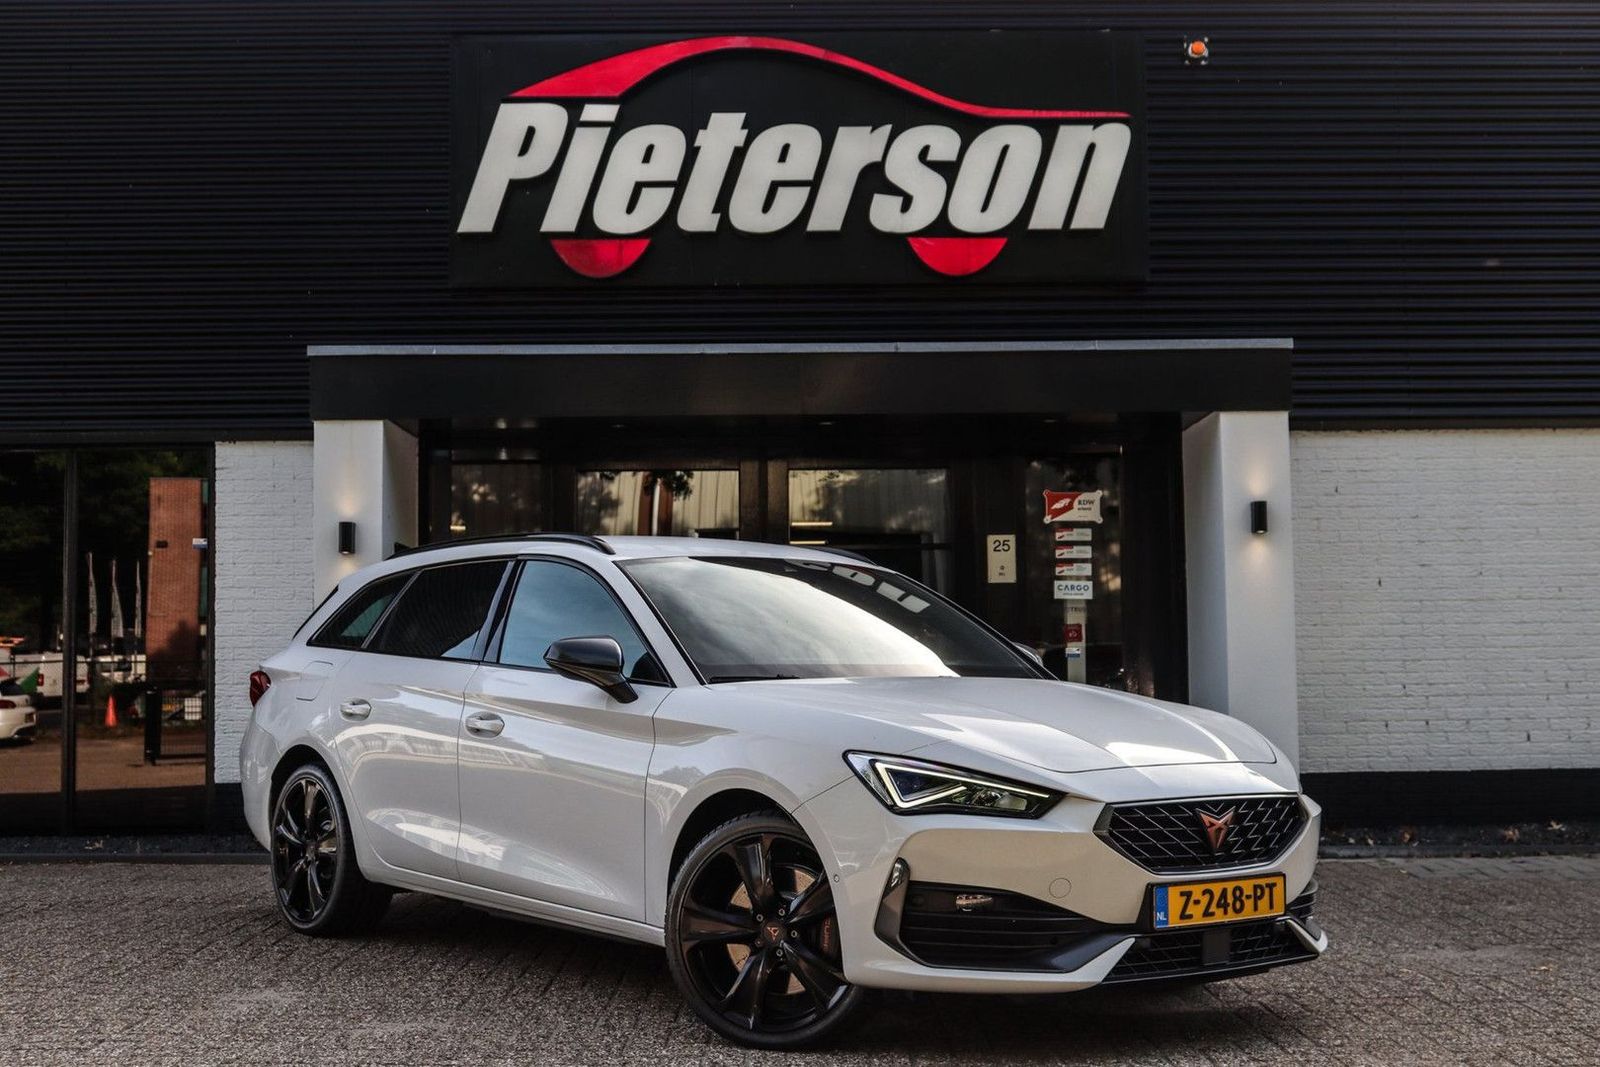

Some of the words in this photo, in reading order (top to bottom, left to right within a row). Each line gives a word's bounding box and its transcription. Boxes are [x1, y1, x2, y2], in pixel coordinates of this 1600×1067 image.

[457, 102, 1132, 235] Pieterson
[993, 539, 1011, 552] 25
[1057, 584, 1090, 592] CARGO
[1179, 882, 1277, 921] Z-248-PT
[1156, 912, 1167, 921] NL
